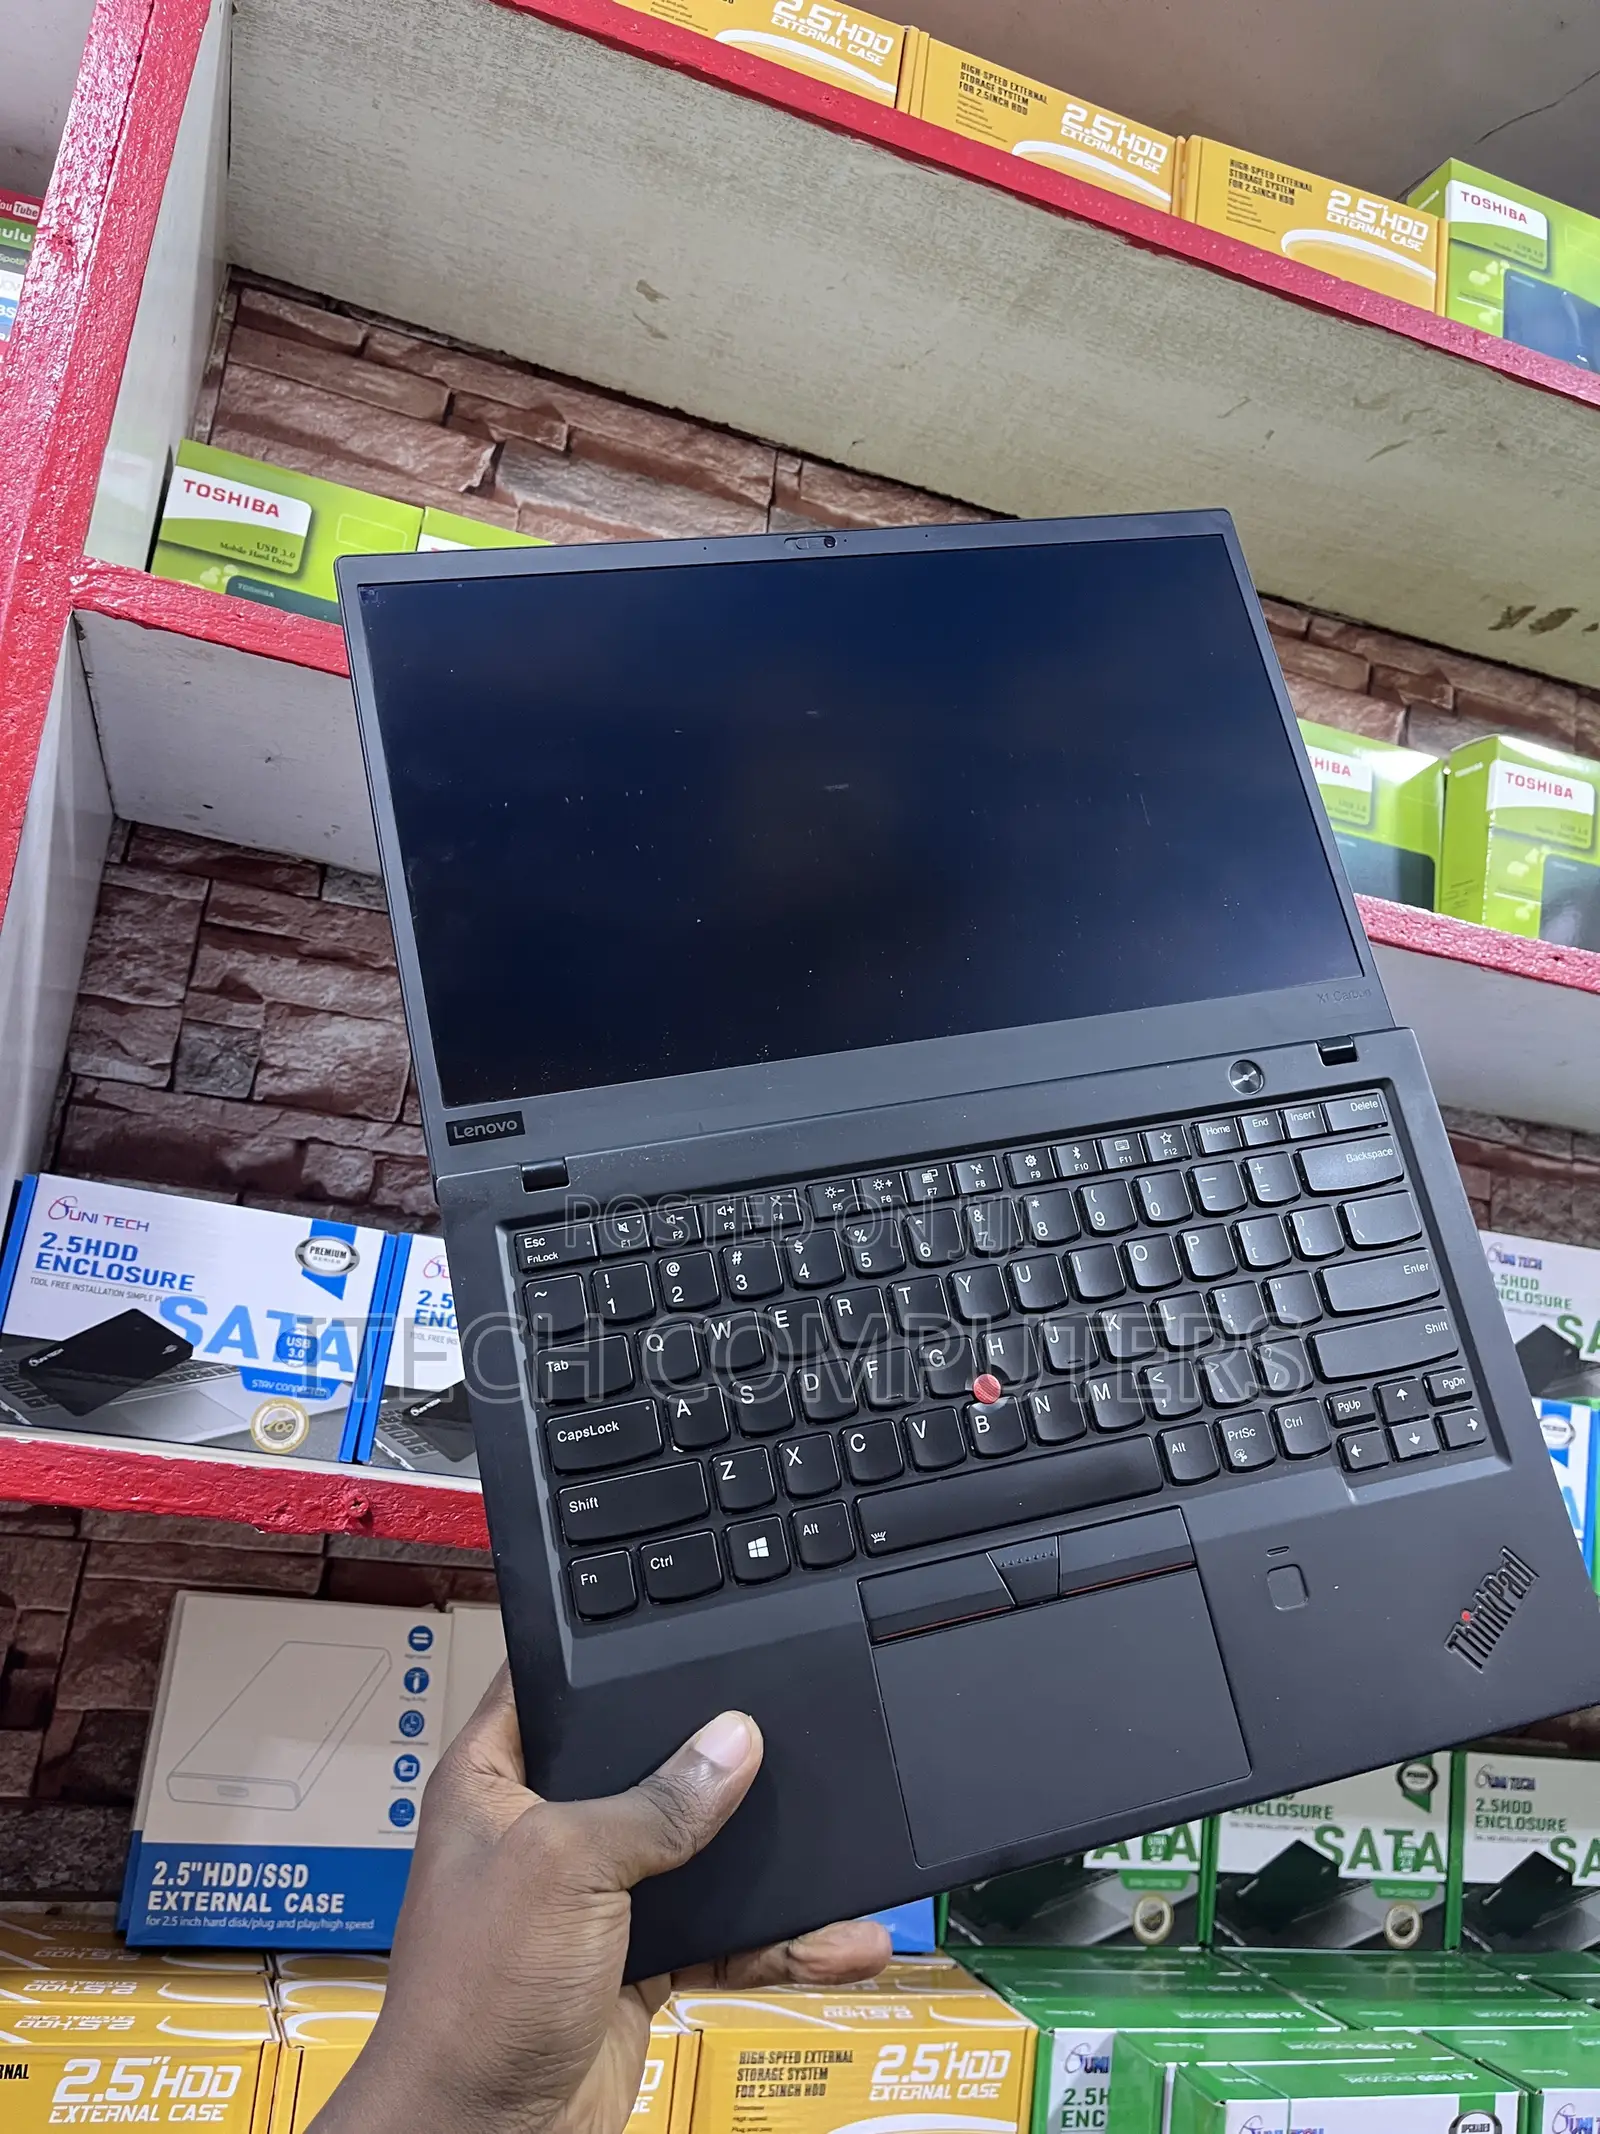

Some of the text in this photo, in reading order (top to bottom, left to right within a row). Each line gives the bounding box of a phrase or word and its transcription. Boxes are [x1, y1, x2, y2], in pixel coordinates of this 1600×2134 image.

[771, 14, 885, 66] EXTERNAL CASE
[959, 82, 975, 95] FOR
[960, 72, 1029, 106] STORAGE SYSTEM
[1010, 80, 1048, 105] EXTERNAL
[1060, 125, 1161, 175] EXTERNAL CASE
[1228, 178, 1244, 190] FOR
[1229, 168, 1295, 197] STORAGE SYSTEM
[15, 204, 38, 217] Tube
[1460, 190, 1528, 225] TOSHIBA
[0, 228, 31, 243] ulu
[1326, 212, 1424, 252] EXTERNAL CASE
[183, 478, 280, 519] TOSHIBA
[220, 542, 247, 555] Mobile
[271, 556, 293, 568] Drive
[256, 541, 278, 554] USB
[1309, 756, 1351, 777] HIBA
[1505, 772, 1573, 800] TOSHIBA
[1350, 1099, 1379, 1112] Delete
[1252, 1117, 1269, 1128] End
[1290, 1109, 1316, 1122] Insert
[453, 1118, 518, 1140] Lenovo
[1206, 1124, 1231, 1136] Home
[1346, 1146, 1393, 1164] Backspace
[1150, 1202, 1161, 1217] 0
[103, 1215, 150, 1233] TECH
[1094, 1211, 1106, 1226] 9
[1037, 1221, 1049, 1237] 8
[40, 1232, 139, 1262] 2.5HDD
[524, 1236, 546, 1249] Esc
[977, 1231, 988, 1247] 7
[1188, 1236, 1200, 1251] P
[309, 1245, 348, 1259] PREMIUM
[527, 1251, 559, 1264] FnLock
[919, 1242, 932, 1258] 6
[1133, 1246, 1148, 1261] O
[860, 1252, 872, 1269] 5
[1074, 1256, 1082, 1273] I
[1403, 1262, 1430, 1276] Enter
[35, 1252, 196, 1292] ENCLOSURE
[798, 1263, 811, 1280] 4
[1017, 1265, 1031, 1282] U
[30, 1276, 153, 1302] TOOL FREE INSTALLATION SIMPLE
[735, 1274, 748, 1291] 3
[958, 1276, 973, 1292] Y
[1496, 1273, 1540, 1290] .5HDD
[671, 1286, 684, 1303] 2
[898, 1286, 911, 1304] T
[607, 1298, 617, 1315] 1
[836, 1299, 853, 1317] R
[1164, 1304, 1177, 1322] L
[774, 1310, 790, 1329] E
[1106, 1314, 1121, 1332] K
[1425, 1320, 1449, 1335] Shift
[158, 1295, 354, 1374] SATA
[711, 1320, 732, 1341] W
[1050, 1326, 1060, 1343] J
[286, 1336, 311, 1349] USB
[427, 1335, 445, 1344] FREE
[646, 1334, 665, 1353] Q
[988, 1337, 1005, 1356] H
[287, 1348, 306, 1359] 3.0
[928, 1349, 946, 1367] G
[546, 1360, 569, 1374] Tab
[866, 1360, 878, 1379] F
[803, 1373, 819, 1391] D
[1442, 1376, 1466, 1391] PgDn
[740, 1385, 755, 1404] S
[1092, 1383, 1111, 1402] M
[676, 1398, 692, 1418] A
[1034, 1396, 1051, 1415] N
[1337, 1399, 1361, 1413] PgUp
[556, 1421, 620, 1443] CapsLock
[912, 1420, 928, 1440] V
[975, 1416, 990, 1434] B
[1284, 1417, 1303, 1430] Ctrl
[1227, 1426, 1256, 1441] PrtSc
[850, 1434, 867, 1452] C
[1171, 1442, 1186, 1454] Alt
[786, 1447, 803, 1466] X
[720, 1461, 736, 1480] Z
[568, 1497, 600, 1513] Shift
[802, 1524, 819, 1536] Alt
[650, 1555, 673, 1570] Ctrl
[580, 1572, 597, 1586] Fn
[1444, 1545, 1540, 1674] ThinkPad
[1475, 1798, 1533, 1814] 2.5HDD
[1475, 1815, 1567, 1833] ENCLOSURE
[1314, 1825, 1445, 1873] SATA
[152, 1861, 309, 1889] 2.5"HDD/SSD
[148, 1890, 345, 1914] EXTERNAL CASE
[146, 1915, 374, 1932] for 2.5 inch hard disk/plug and play/high speed
[739, 2050, 854, 2065] HIGH-SPEED EXTERNAL
[871, 2042, 1012, 2084] 2.5"HDD
[52, 2056, 242, 2104] 2.5"HDD
[737, 2067, 828, 2081] STORAGE SYSTEM
[735, 2083, 826, 2098] FOR 2.5INCH HDD
[869, 2083, 1001, 2101] EXTERNAL CASE
[48, 2104, 229, 2124] EXTERNAL CASE
